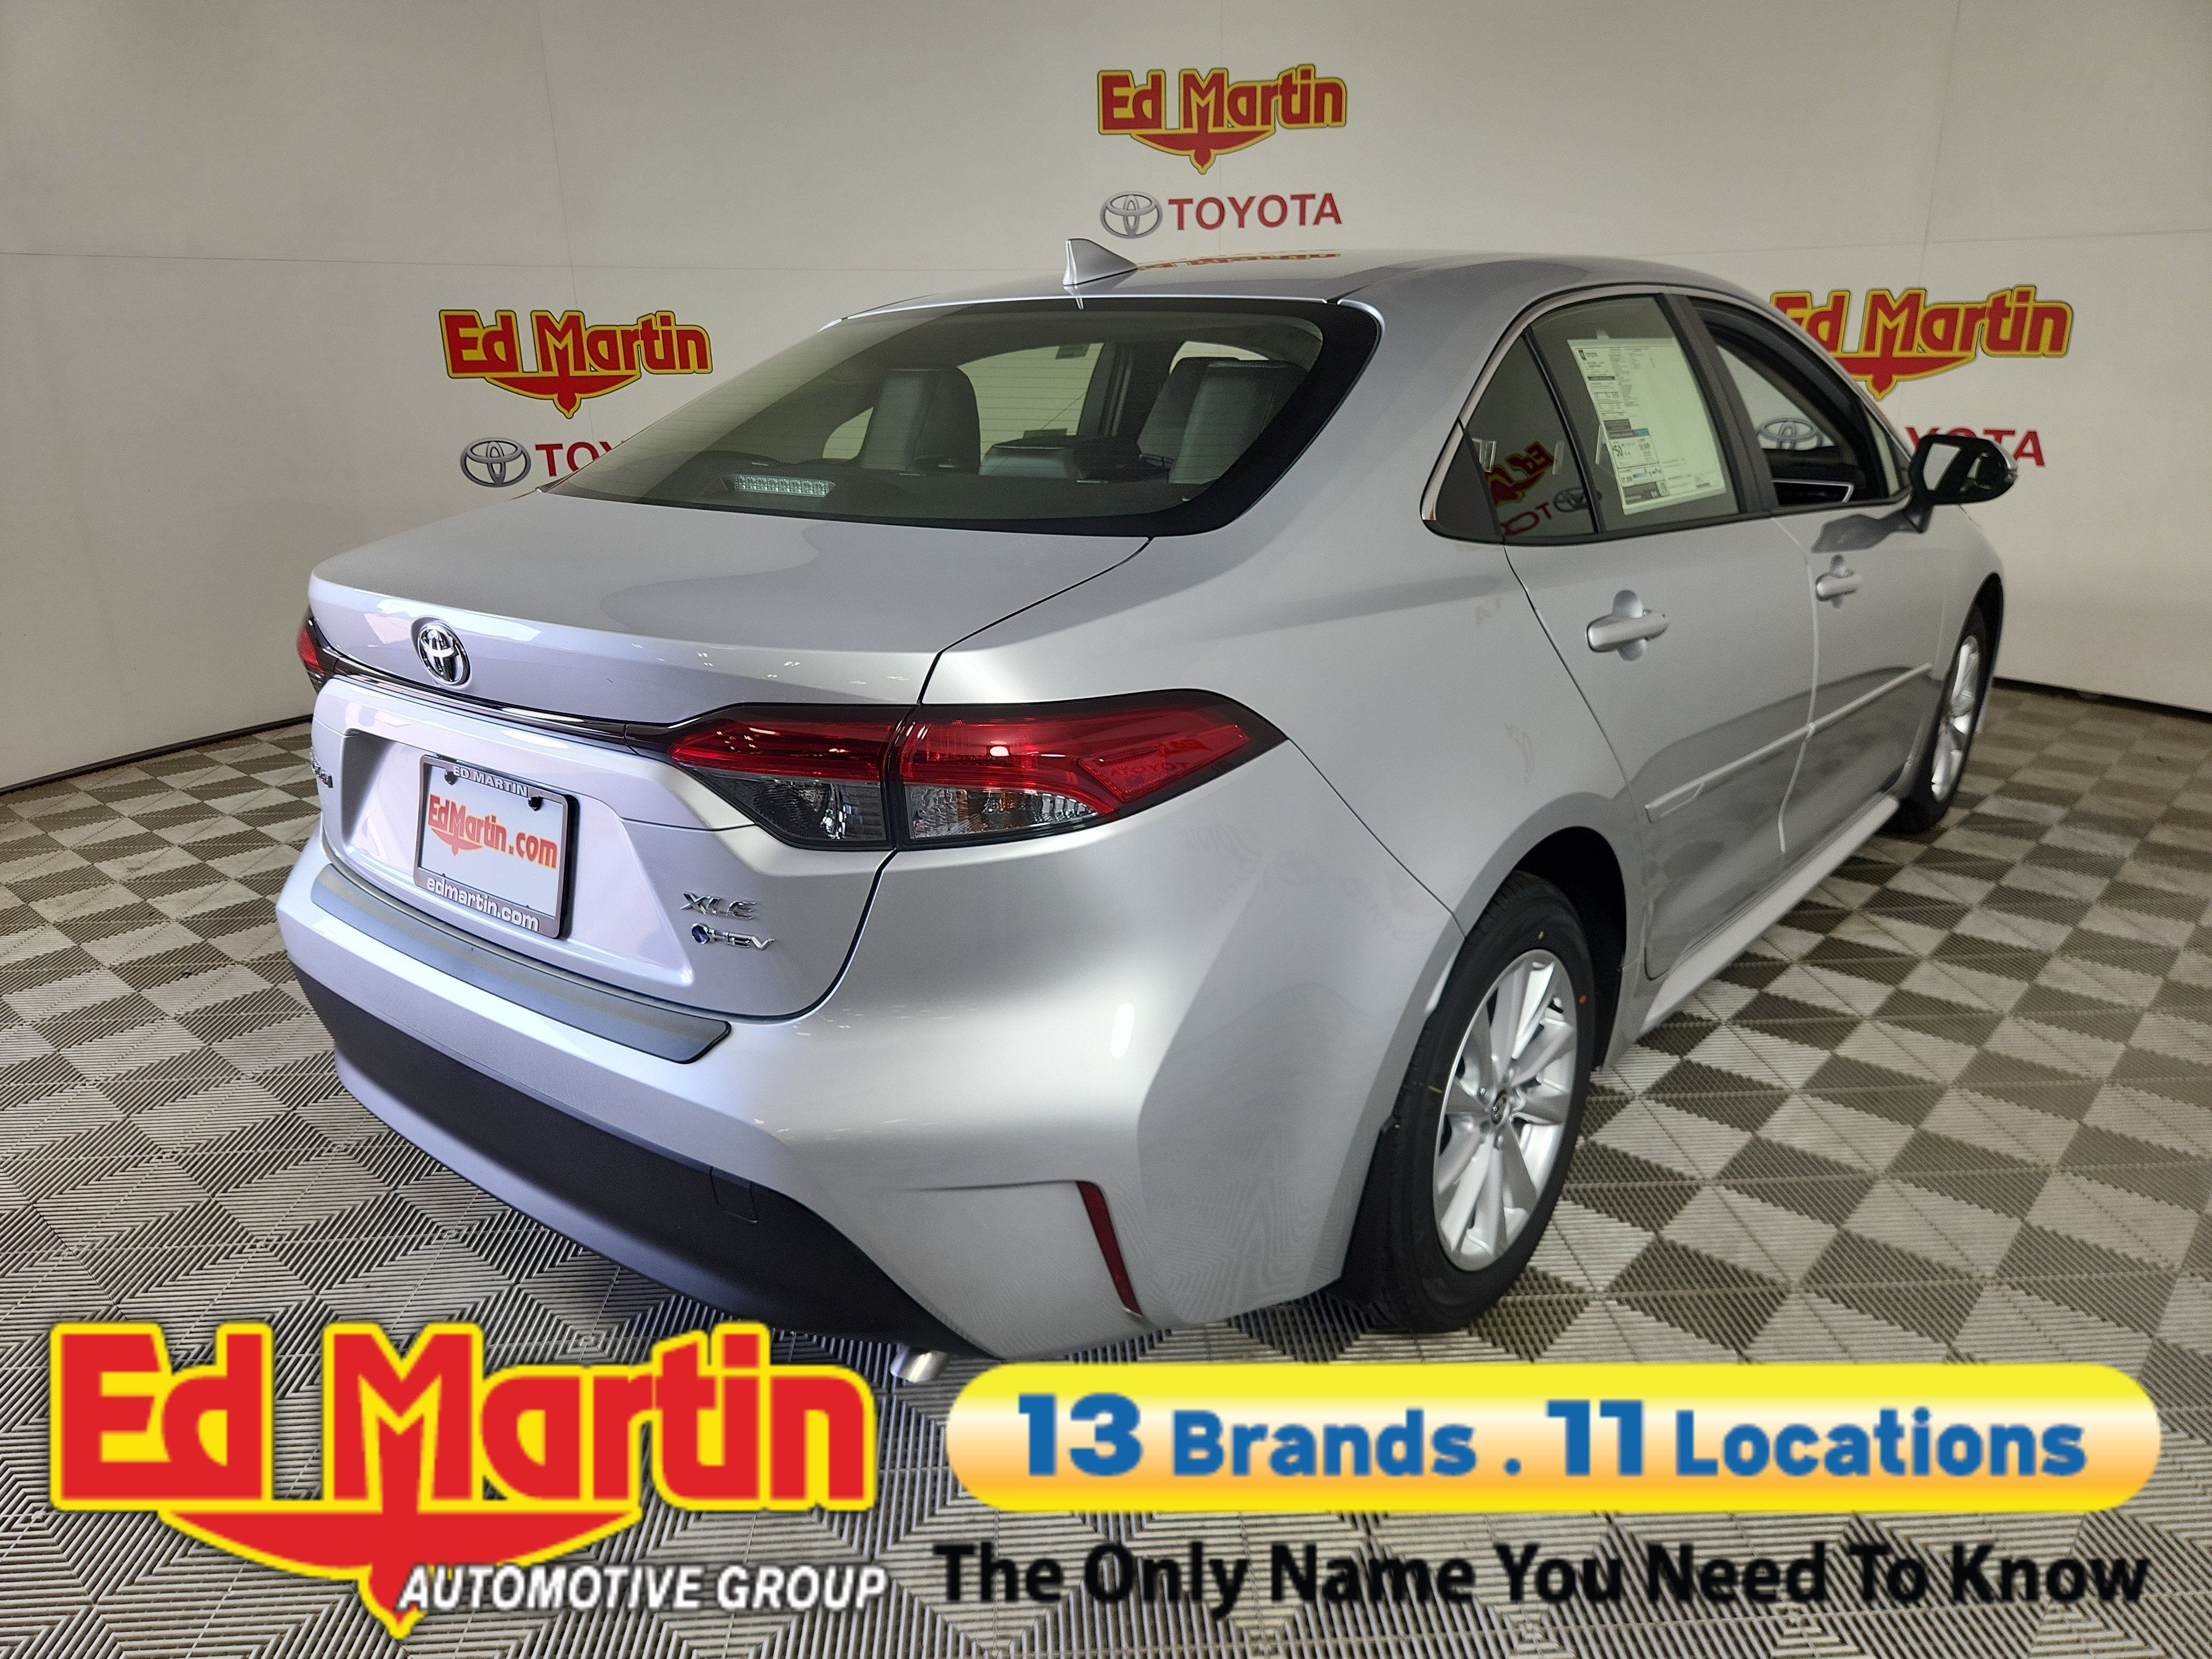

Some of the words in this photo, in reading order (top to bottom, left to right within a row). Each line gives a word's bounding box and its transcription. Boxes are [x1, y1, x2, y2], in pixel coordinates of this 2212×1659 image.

[1098, 70, 1165, 133] Ed
[1179, 64, 1346, 132] Martin
[1168, 192, 1342, 231] TOYOTA
[440, 310, 523, 378] Ed
[531, 311, 713, 375] Martin
[1860, 285, 2073, 357] Martin
[453, 766, 470, 779] ED
[473, 771, 529, 796] MARTIN
[428, 793, 558, 869] EdMartin.com
[427, 876, 539, 933] edmartin.com
[679, 892, 756, 919] XLE
